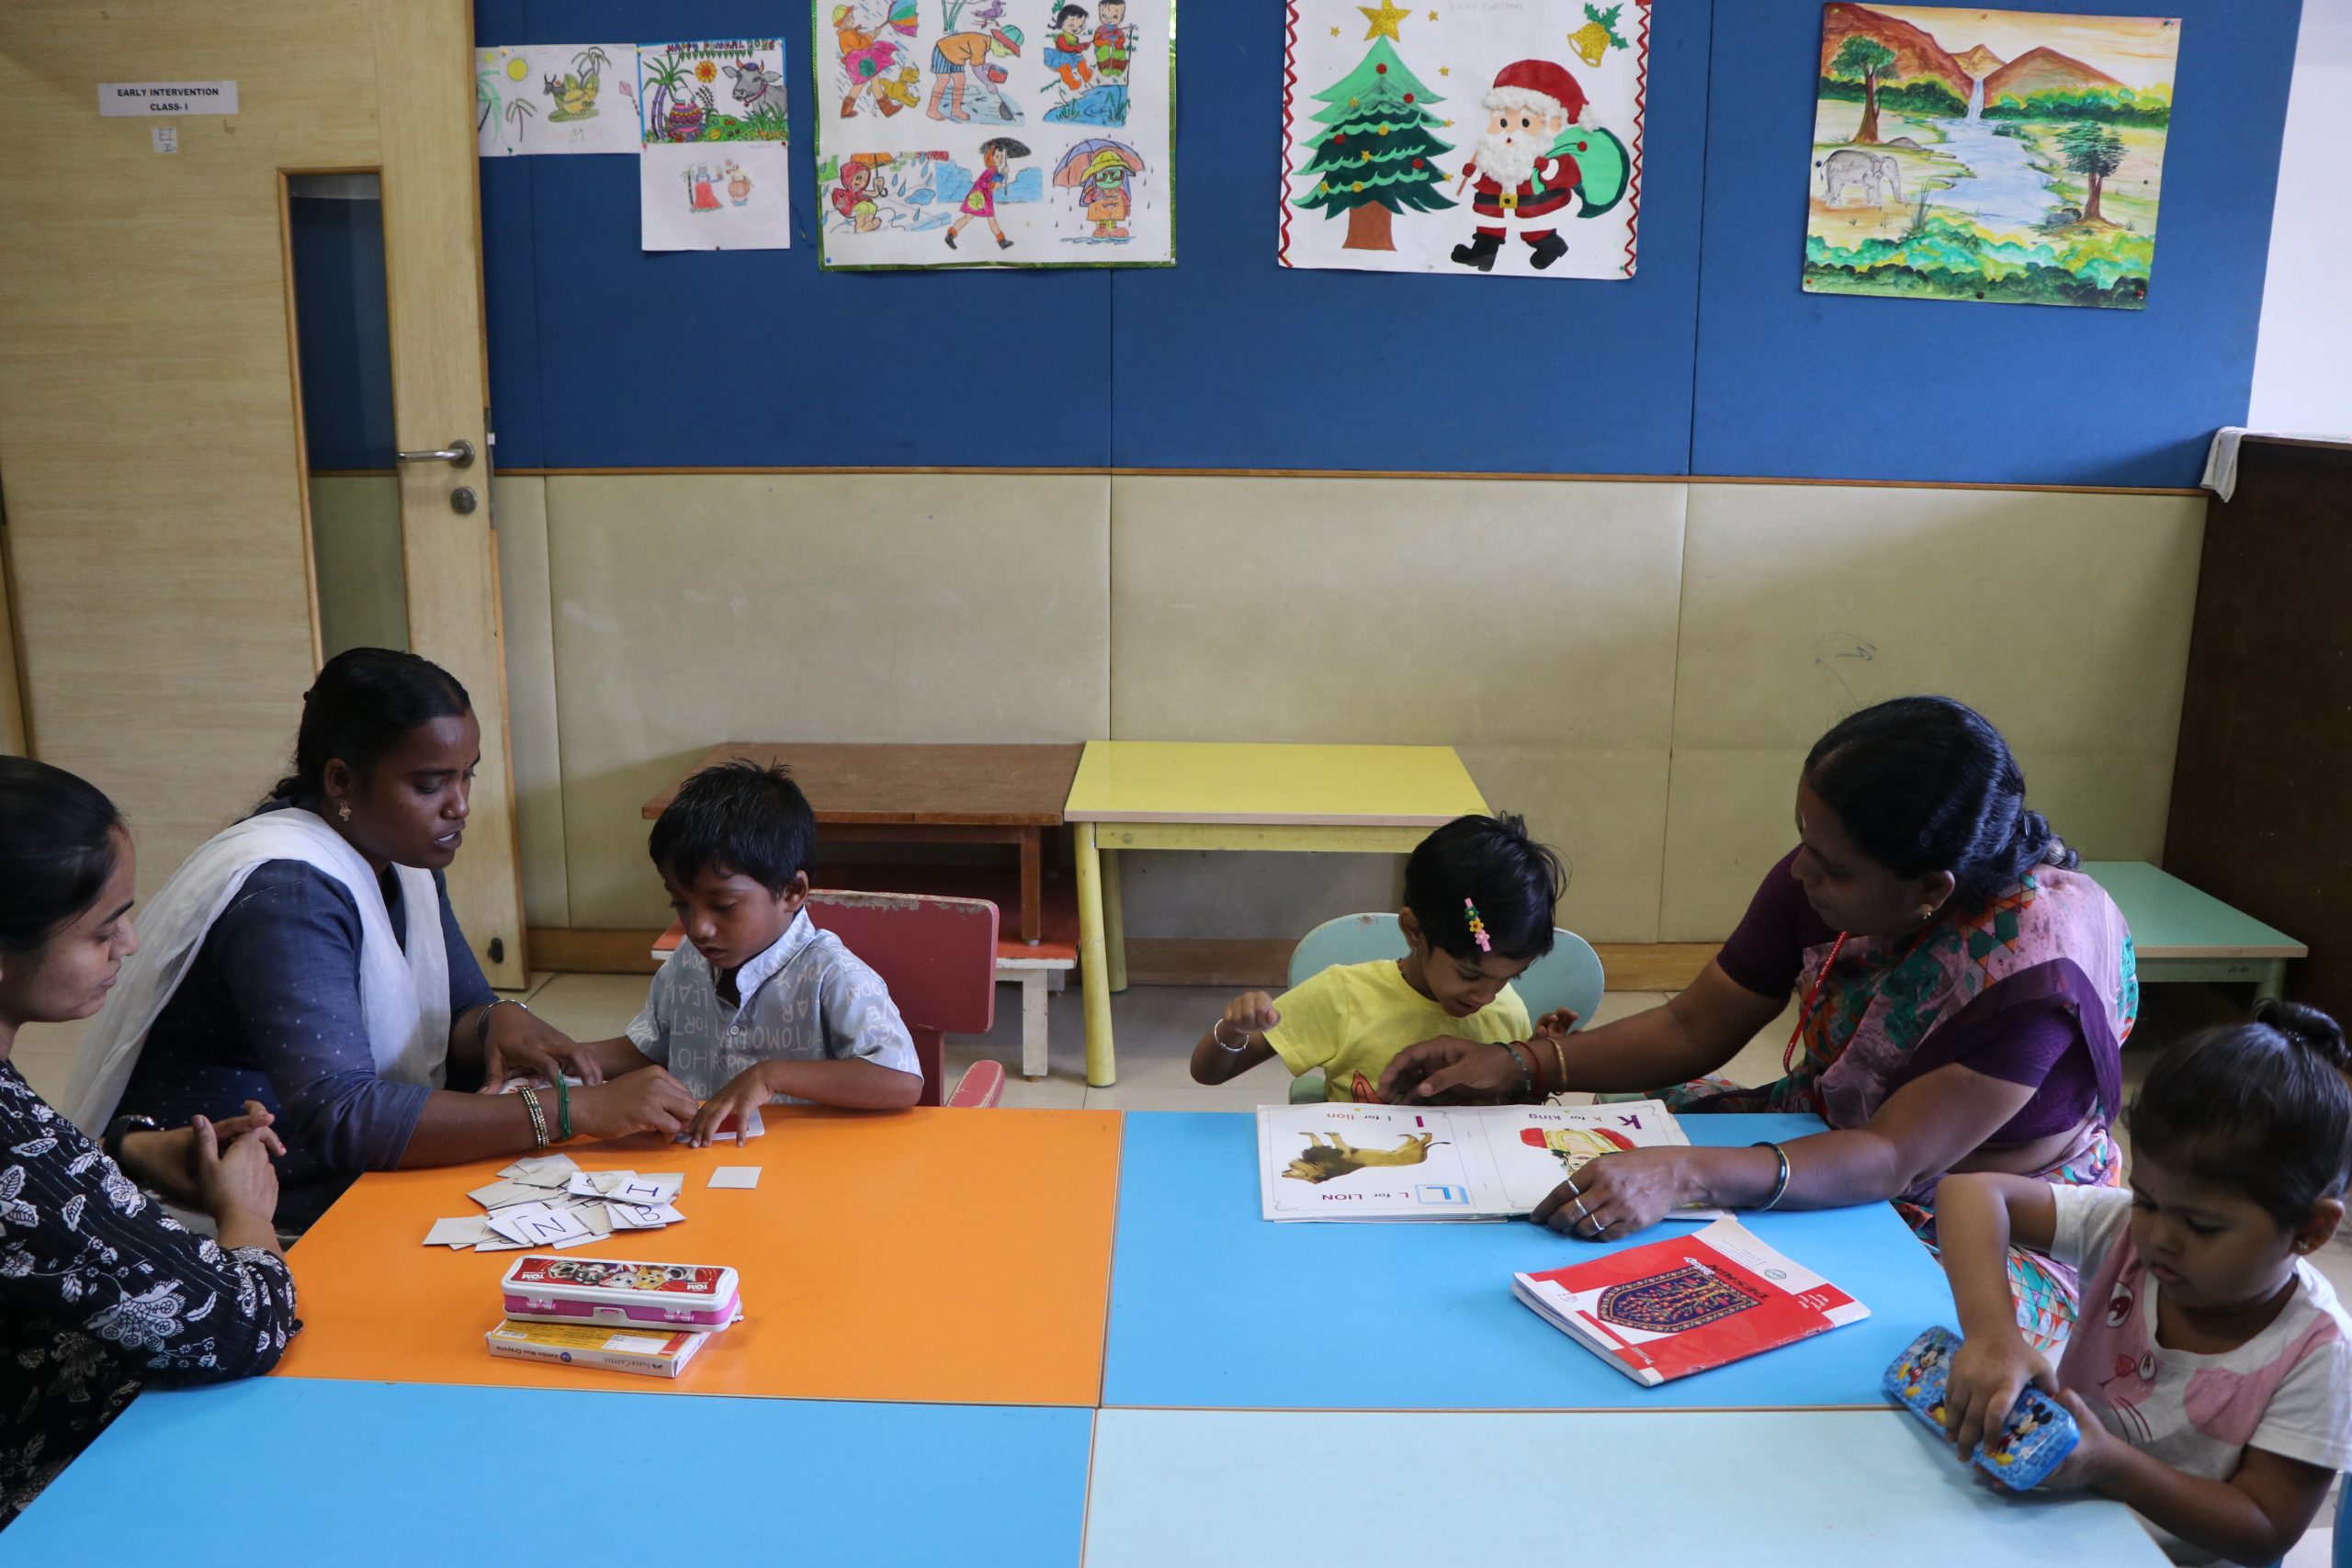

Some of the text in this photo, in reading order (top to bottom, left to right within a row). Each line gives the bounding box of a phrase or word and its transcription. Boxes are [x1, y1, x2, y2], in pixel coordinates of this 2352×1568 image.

[667, 42, 698, 52] HAPPY
[704, 39, 745, 51] PONGAL
[150, 87, 220, 96] INTERVENTION
[1327, 1112, 1355, 1121] lion
[1529, 1112, 1561, 1121] king
[1426, 1186, 1452, 1201] L
[634, 1205, 661, 1222] B
[531, 1216, 567, 1237] N
[496, 1346, 522, 1354] Crayons
[537, 1351, 560, 1359] Jumbo
